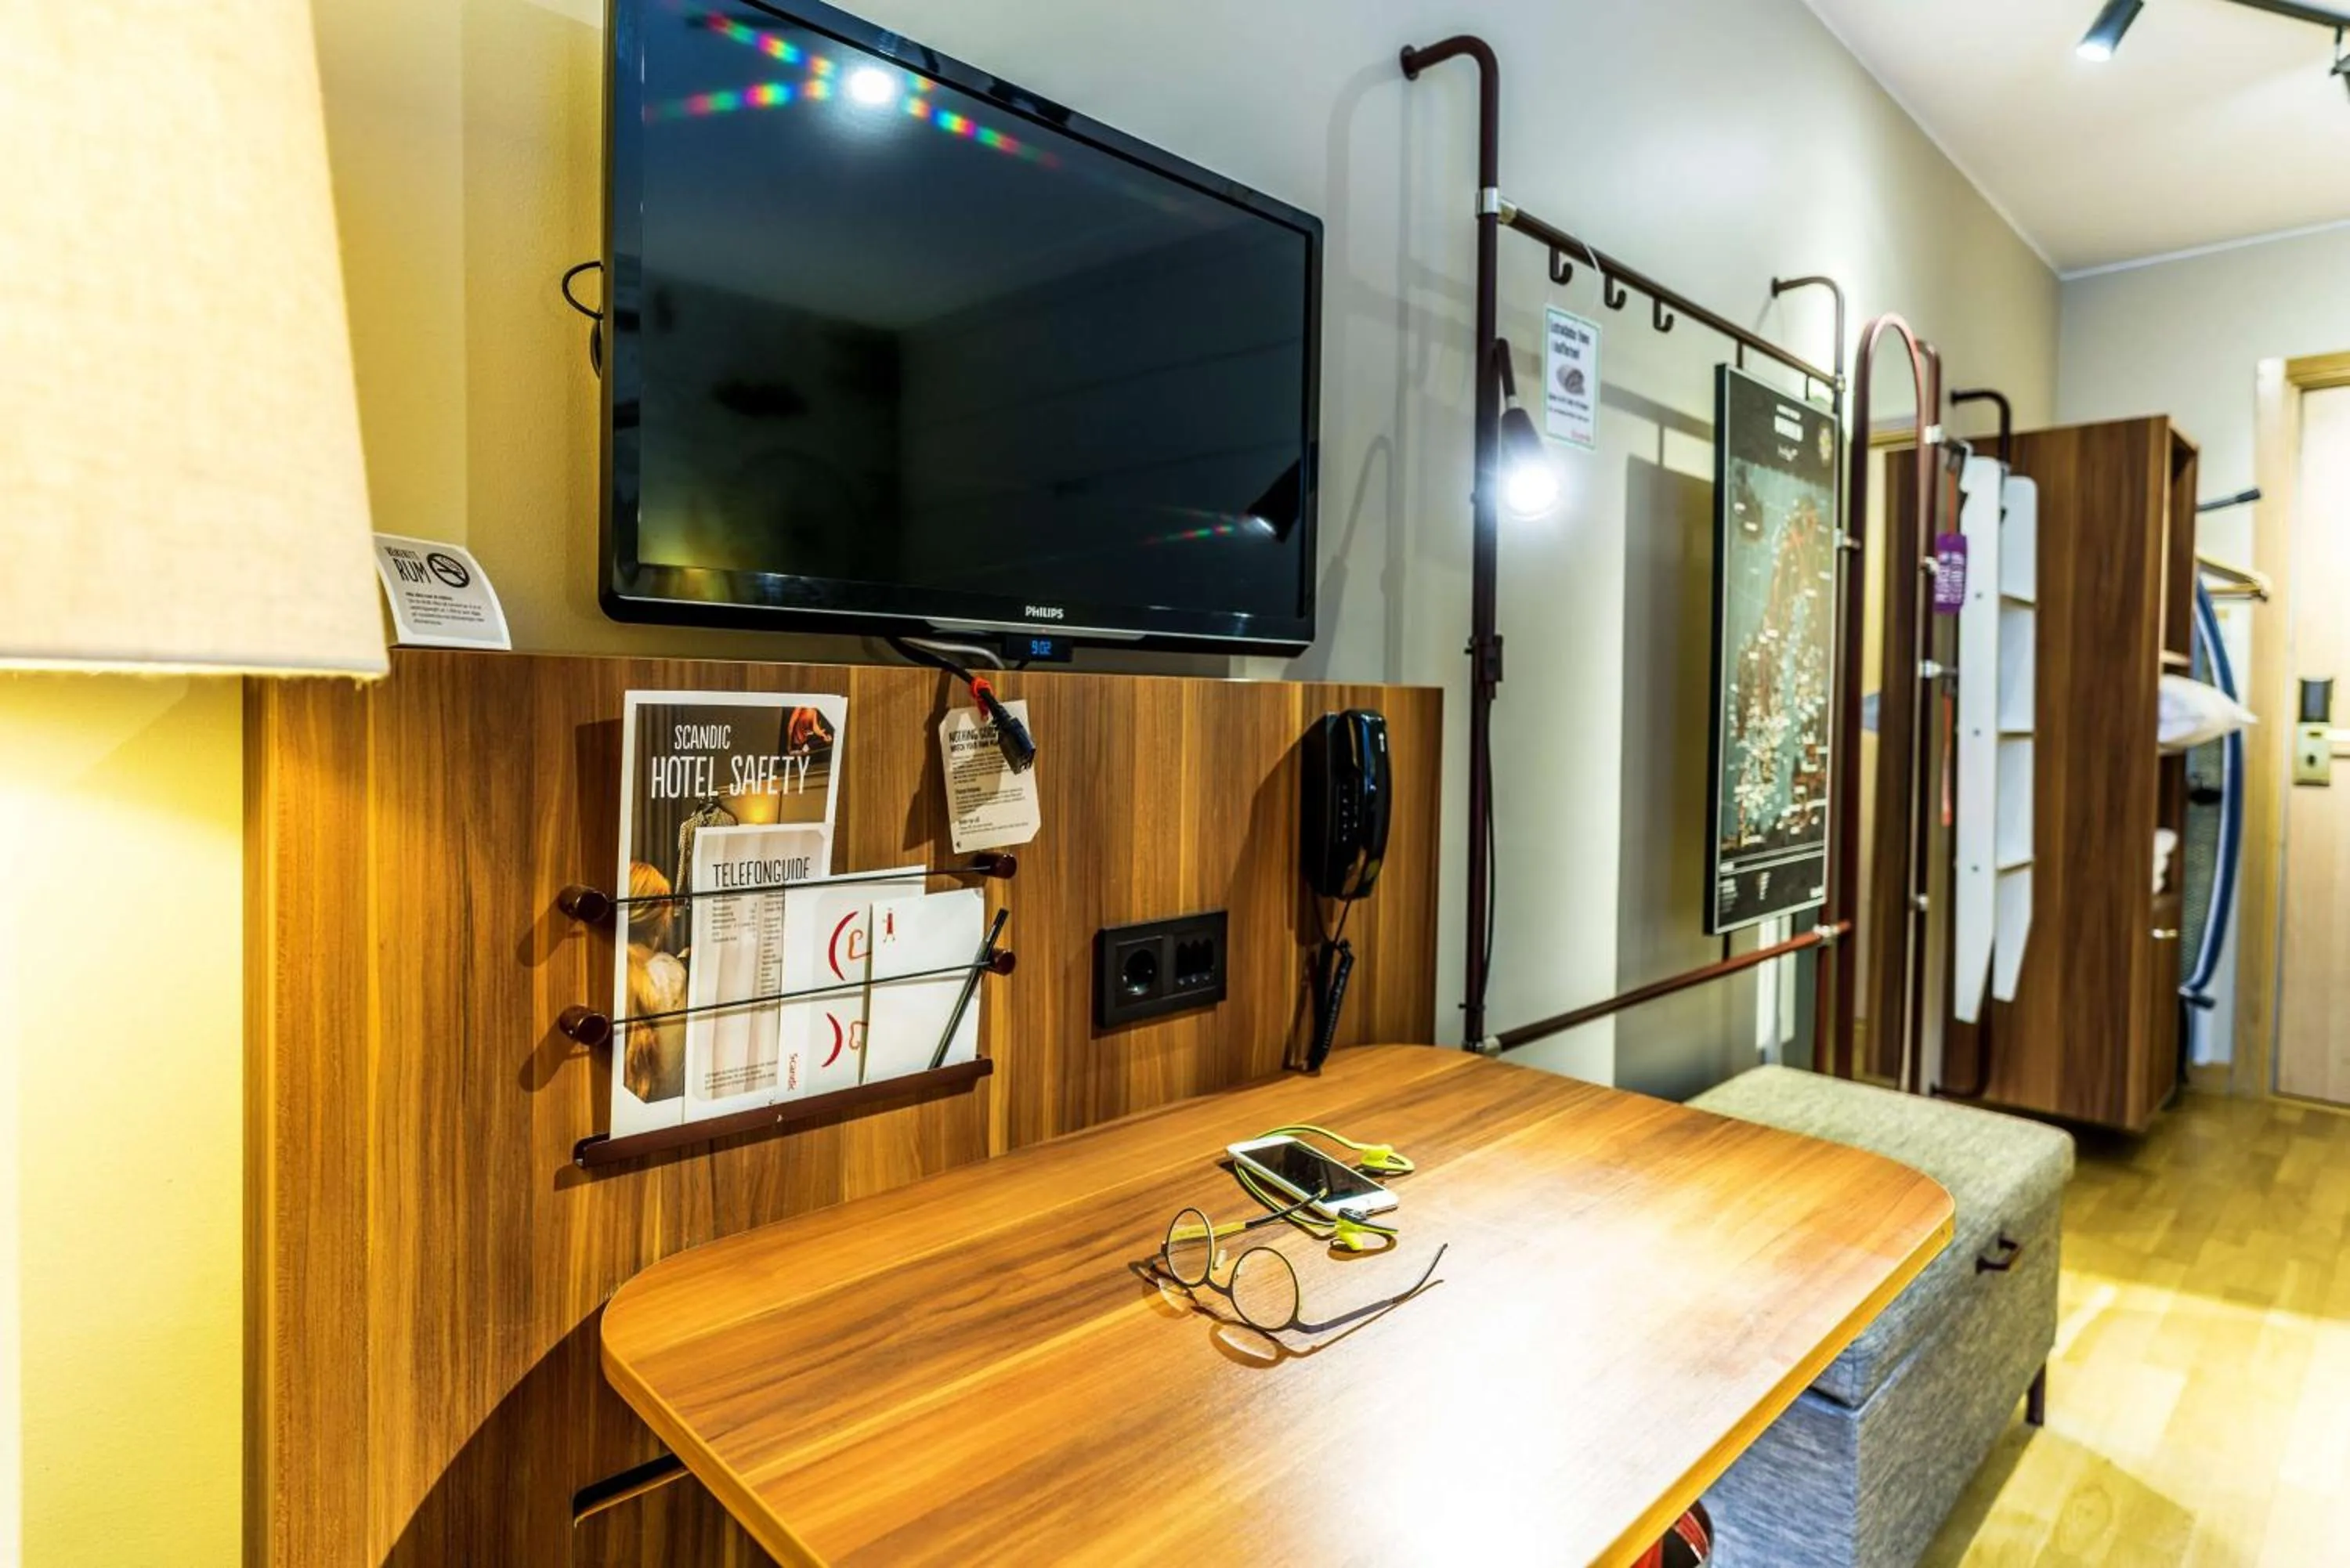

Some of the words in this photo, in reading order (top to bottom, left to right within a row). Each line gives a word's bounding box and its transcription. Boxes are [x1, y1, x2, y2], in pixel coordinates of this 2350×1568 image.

[393, 558, 432, 584] RUM
[1025, 605, 1065, 620] PHILIPS
[674, 724, 732, 750] SCANDIC
[651, 755, 719, 799] HOTEL
[728, 754, 812, 796] SAFETY
[712, 856, 811, 887] TELEFONGUIDE
